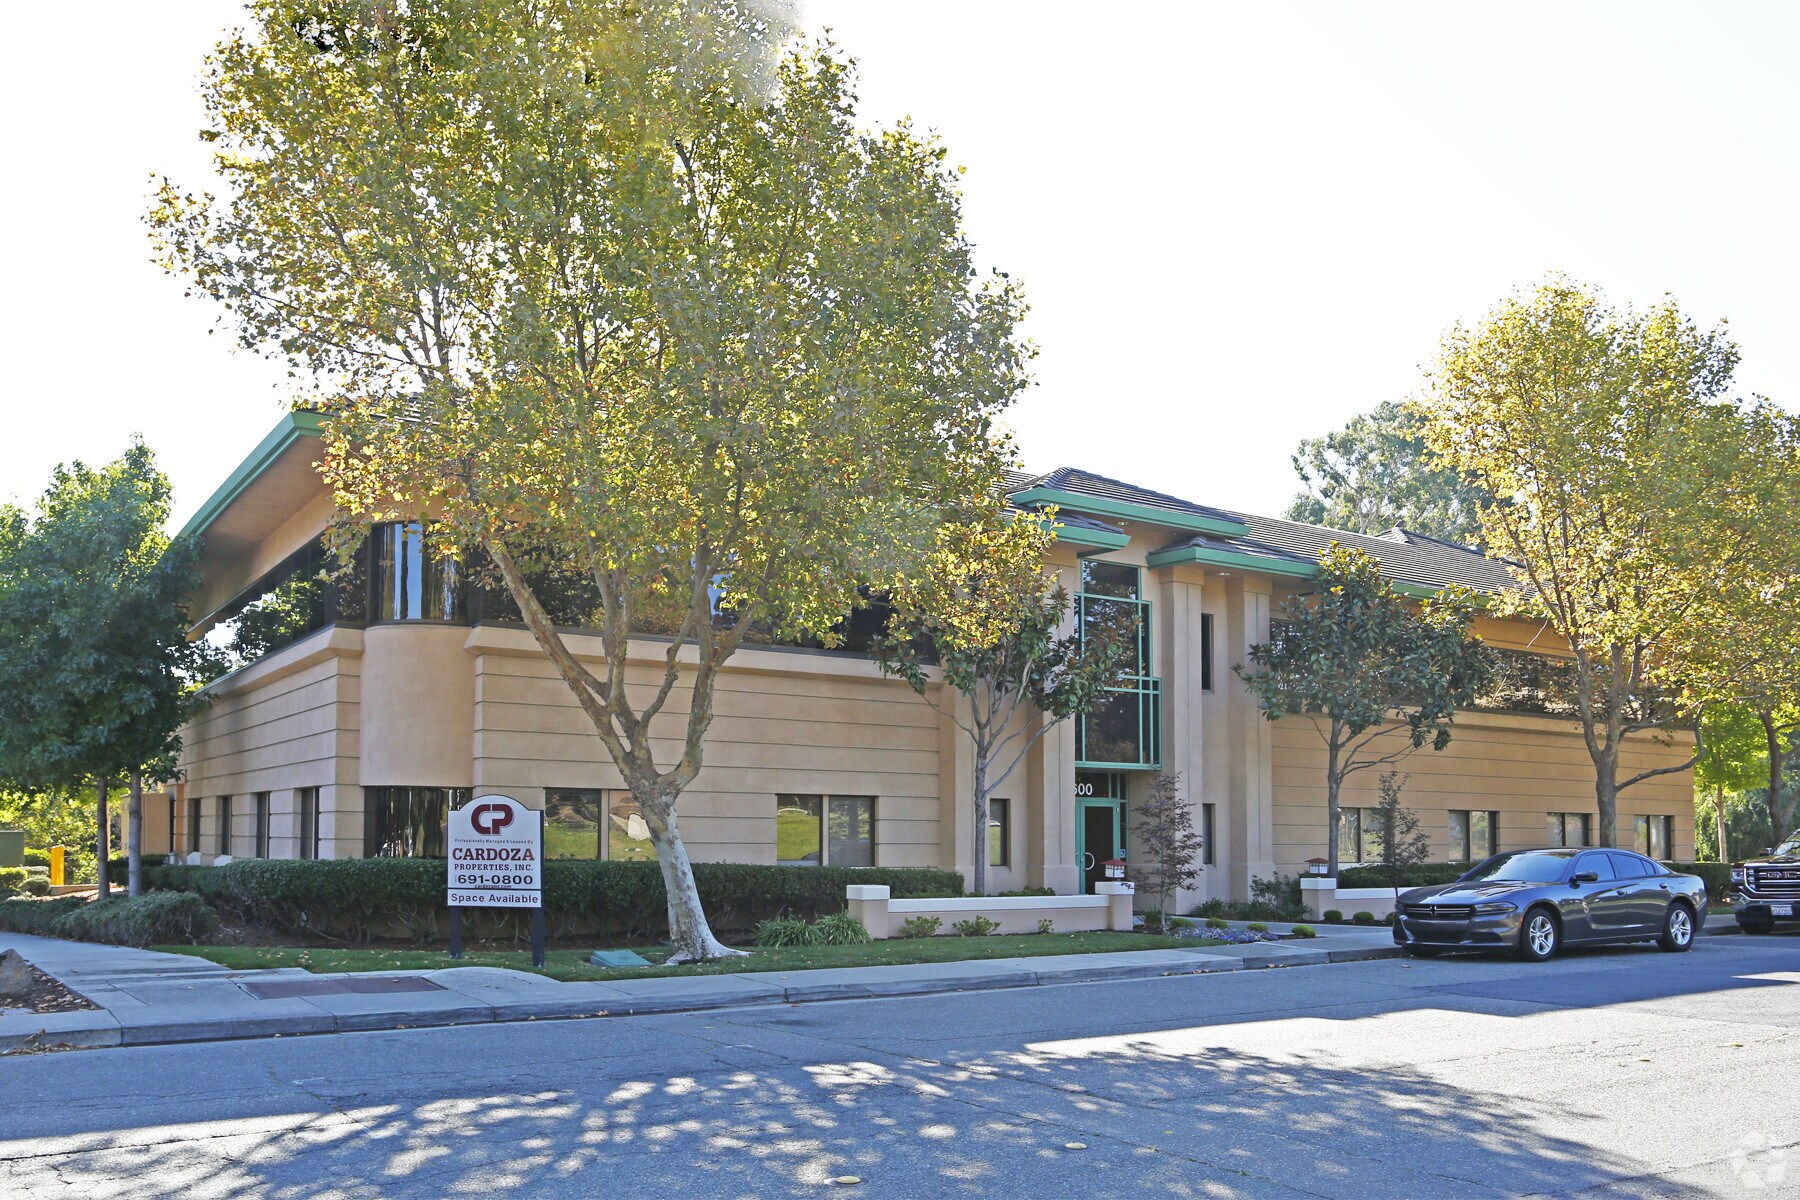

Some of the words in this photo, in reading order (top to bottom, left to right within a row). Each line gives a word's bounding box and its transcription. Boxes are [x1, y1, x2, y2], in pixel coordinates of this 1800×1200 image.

[471, 804, 514, 835] CP
[452, 848, 535, 861] CARDOZA
[458, 874, 533, 885] 691-0800
[451, 893, 485, 903] Space
[489, 893, 539, 903] Available
